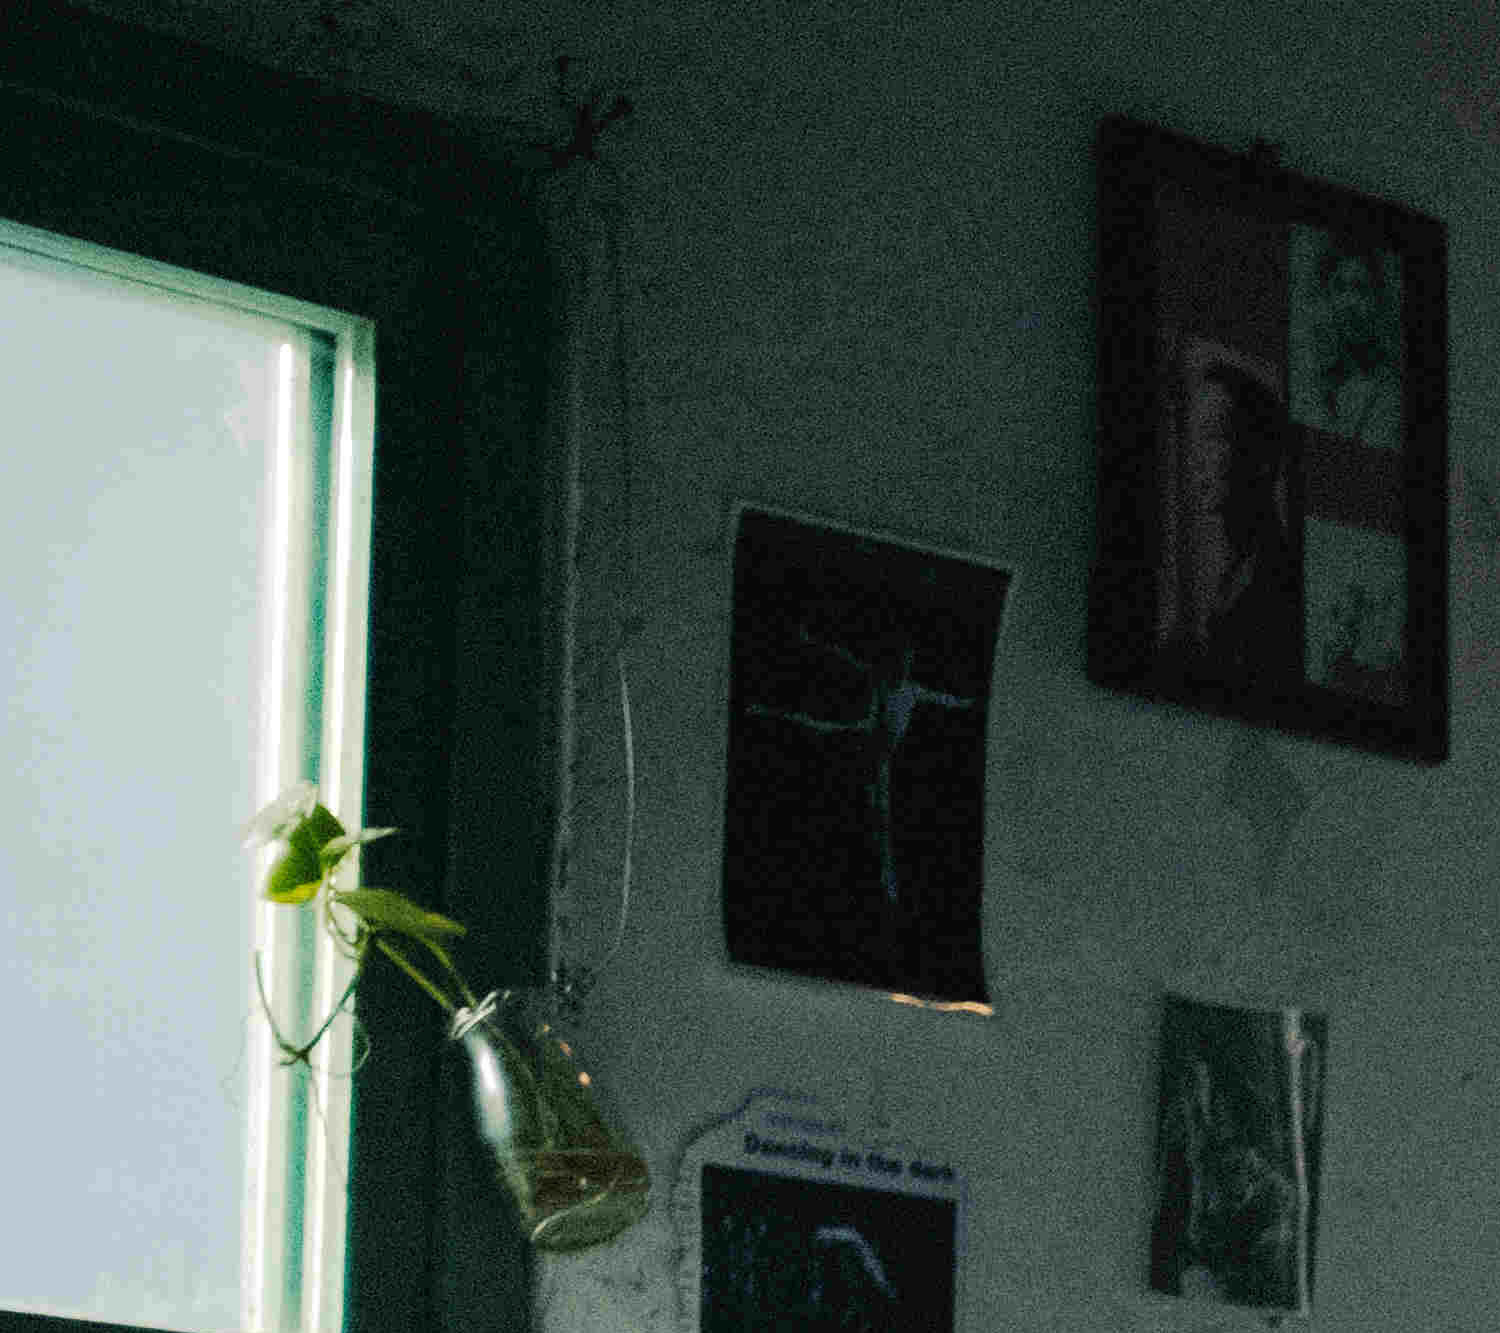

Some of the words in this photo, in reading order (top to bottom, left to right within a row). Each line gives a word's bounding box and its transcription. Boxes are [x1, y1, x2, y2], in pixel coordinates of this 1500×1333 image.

[744, 1132, 834, 1167] Dancing
[839, 1146, 861, 1168] in
[867, 1149, 903, 1174] the
[910, 1155, 955, 1182] dark
